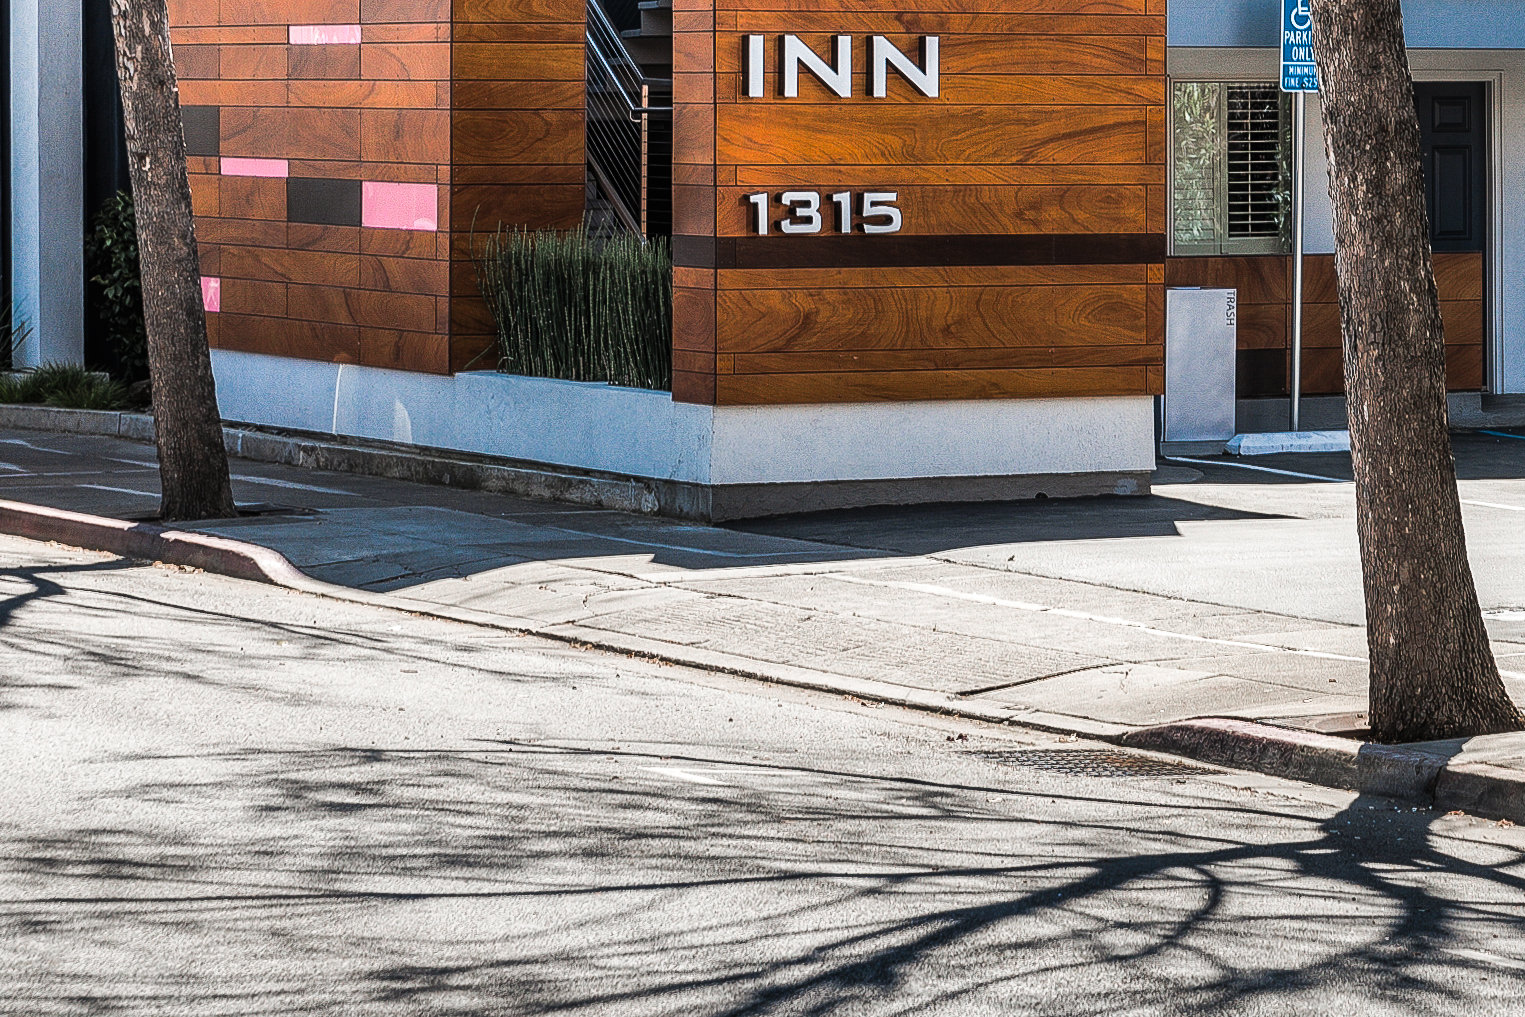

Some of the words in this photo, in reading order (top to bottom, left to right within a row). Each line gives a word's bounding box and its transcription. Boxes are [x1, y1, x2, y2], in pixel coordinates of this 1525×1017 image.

[1284, 30, 1312, 45] PARKI
[744, 34, 939, 98] INN
[748, 191, 903, 235] 1315
[1226, 290, 1236, 326] TRASH
